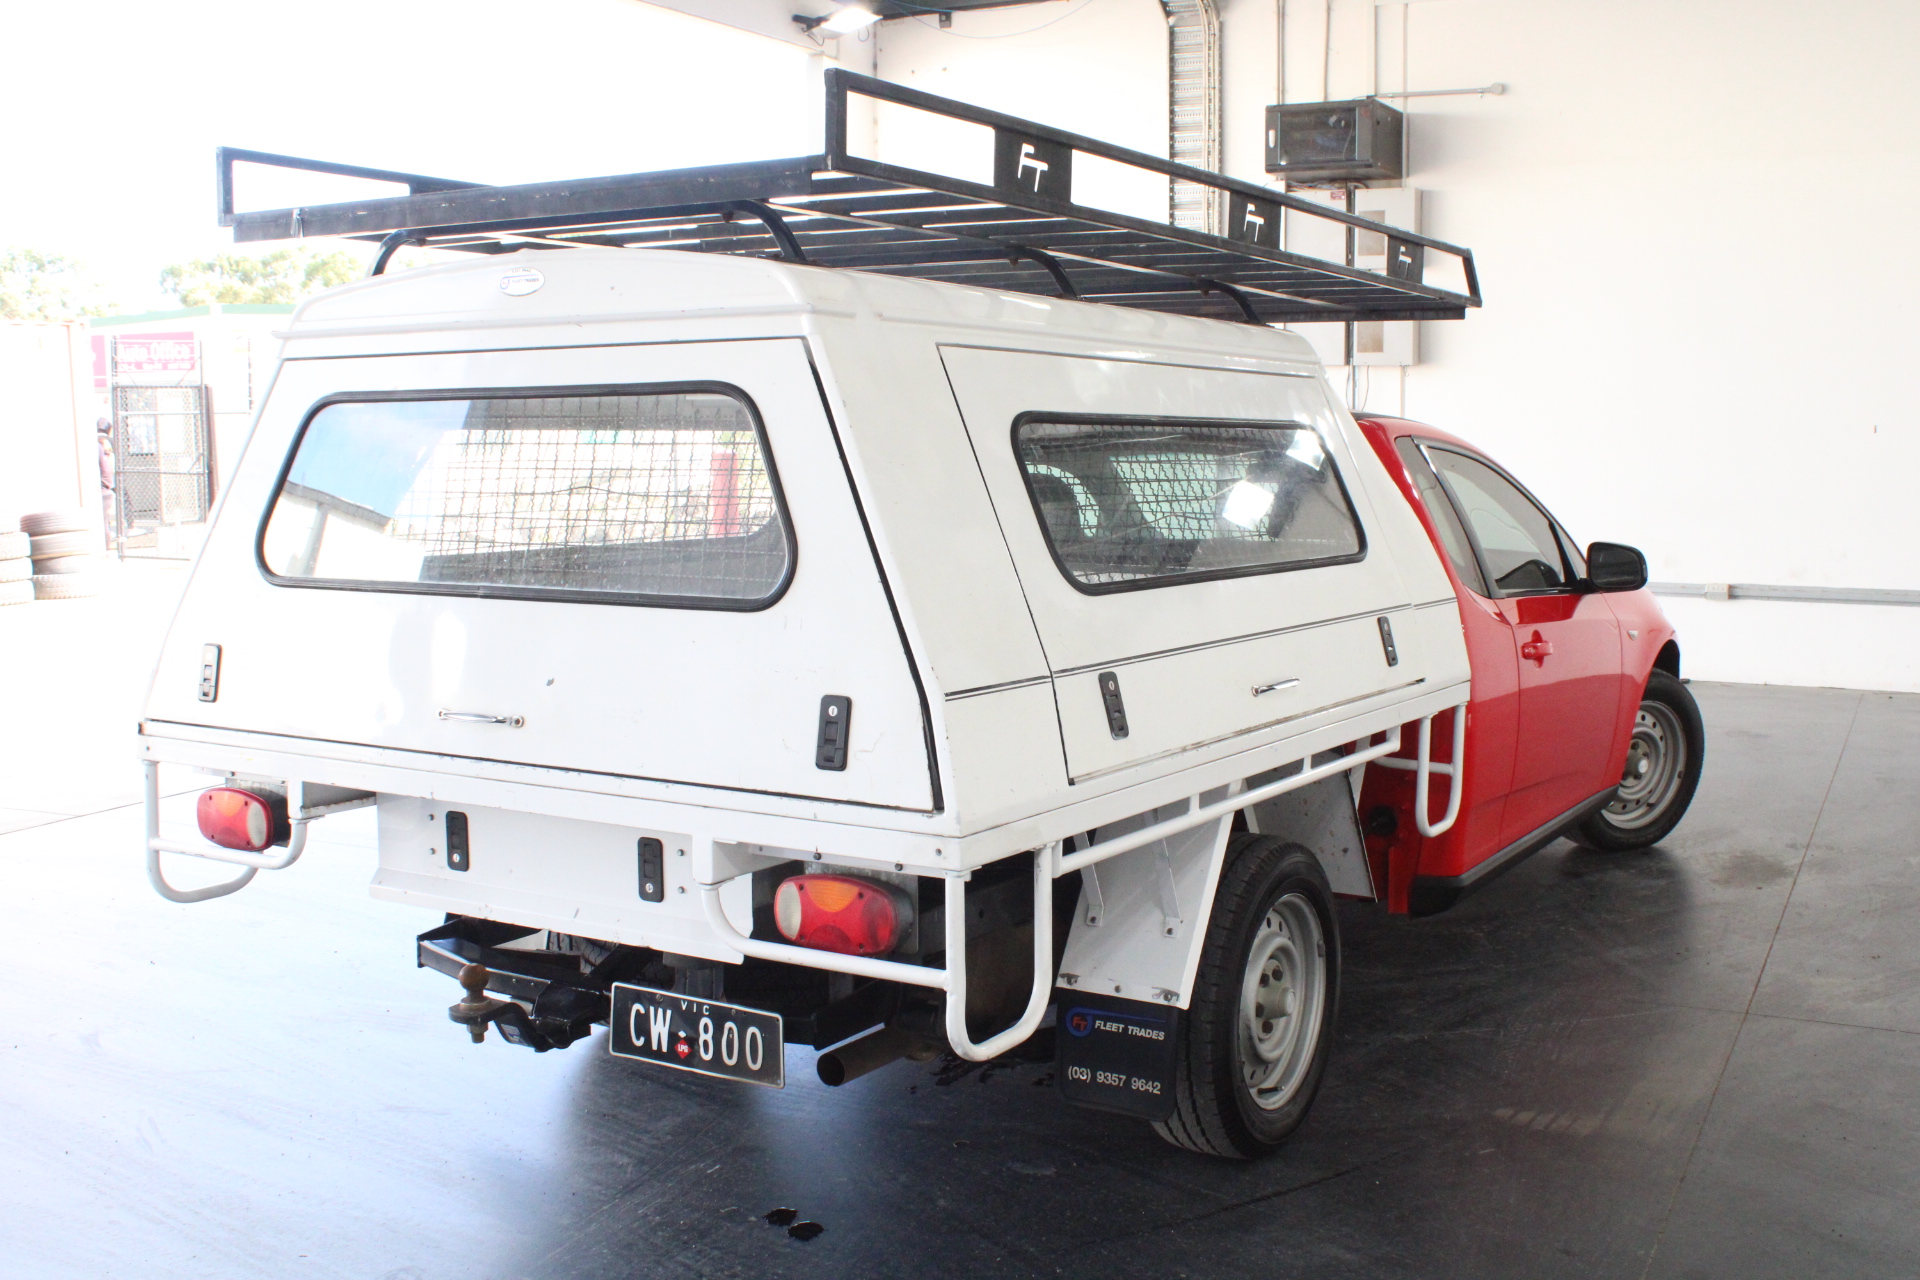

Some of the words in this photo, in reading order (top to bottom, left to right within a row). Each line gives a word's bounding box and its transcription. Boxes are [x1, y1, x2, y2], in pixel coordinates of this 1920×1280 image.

[117, 344, 148, 362] Auto
[150, 342, 191, 360] Office
[680, 1000, 710, 1016] VIC
[629, 1003, 672, 1053] CW
[699, 1017, 763, 1071] 800
[1094, 1020, 1125, 1033] FLEET
[1127, 1025, 1165, 1041] TRADES
[677, 1043, 689, 1053] LPG
[1068, 1065, 1091, 1083] (03)
[1096, 1071, 1127, 1087] 9357
[1131, 1077, 1161, 1095] 9642
